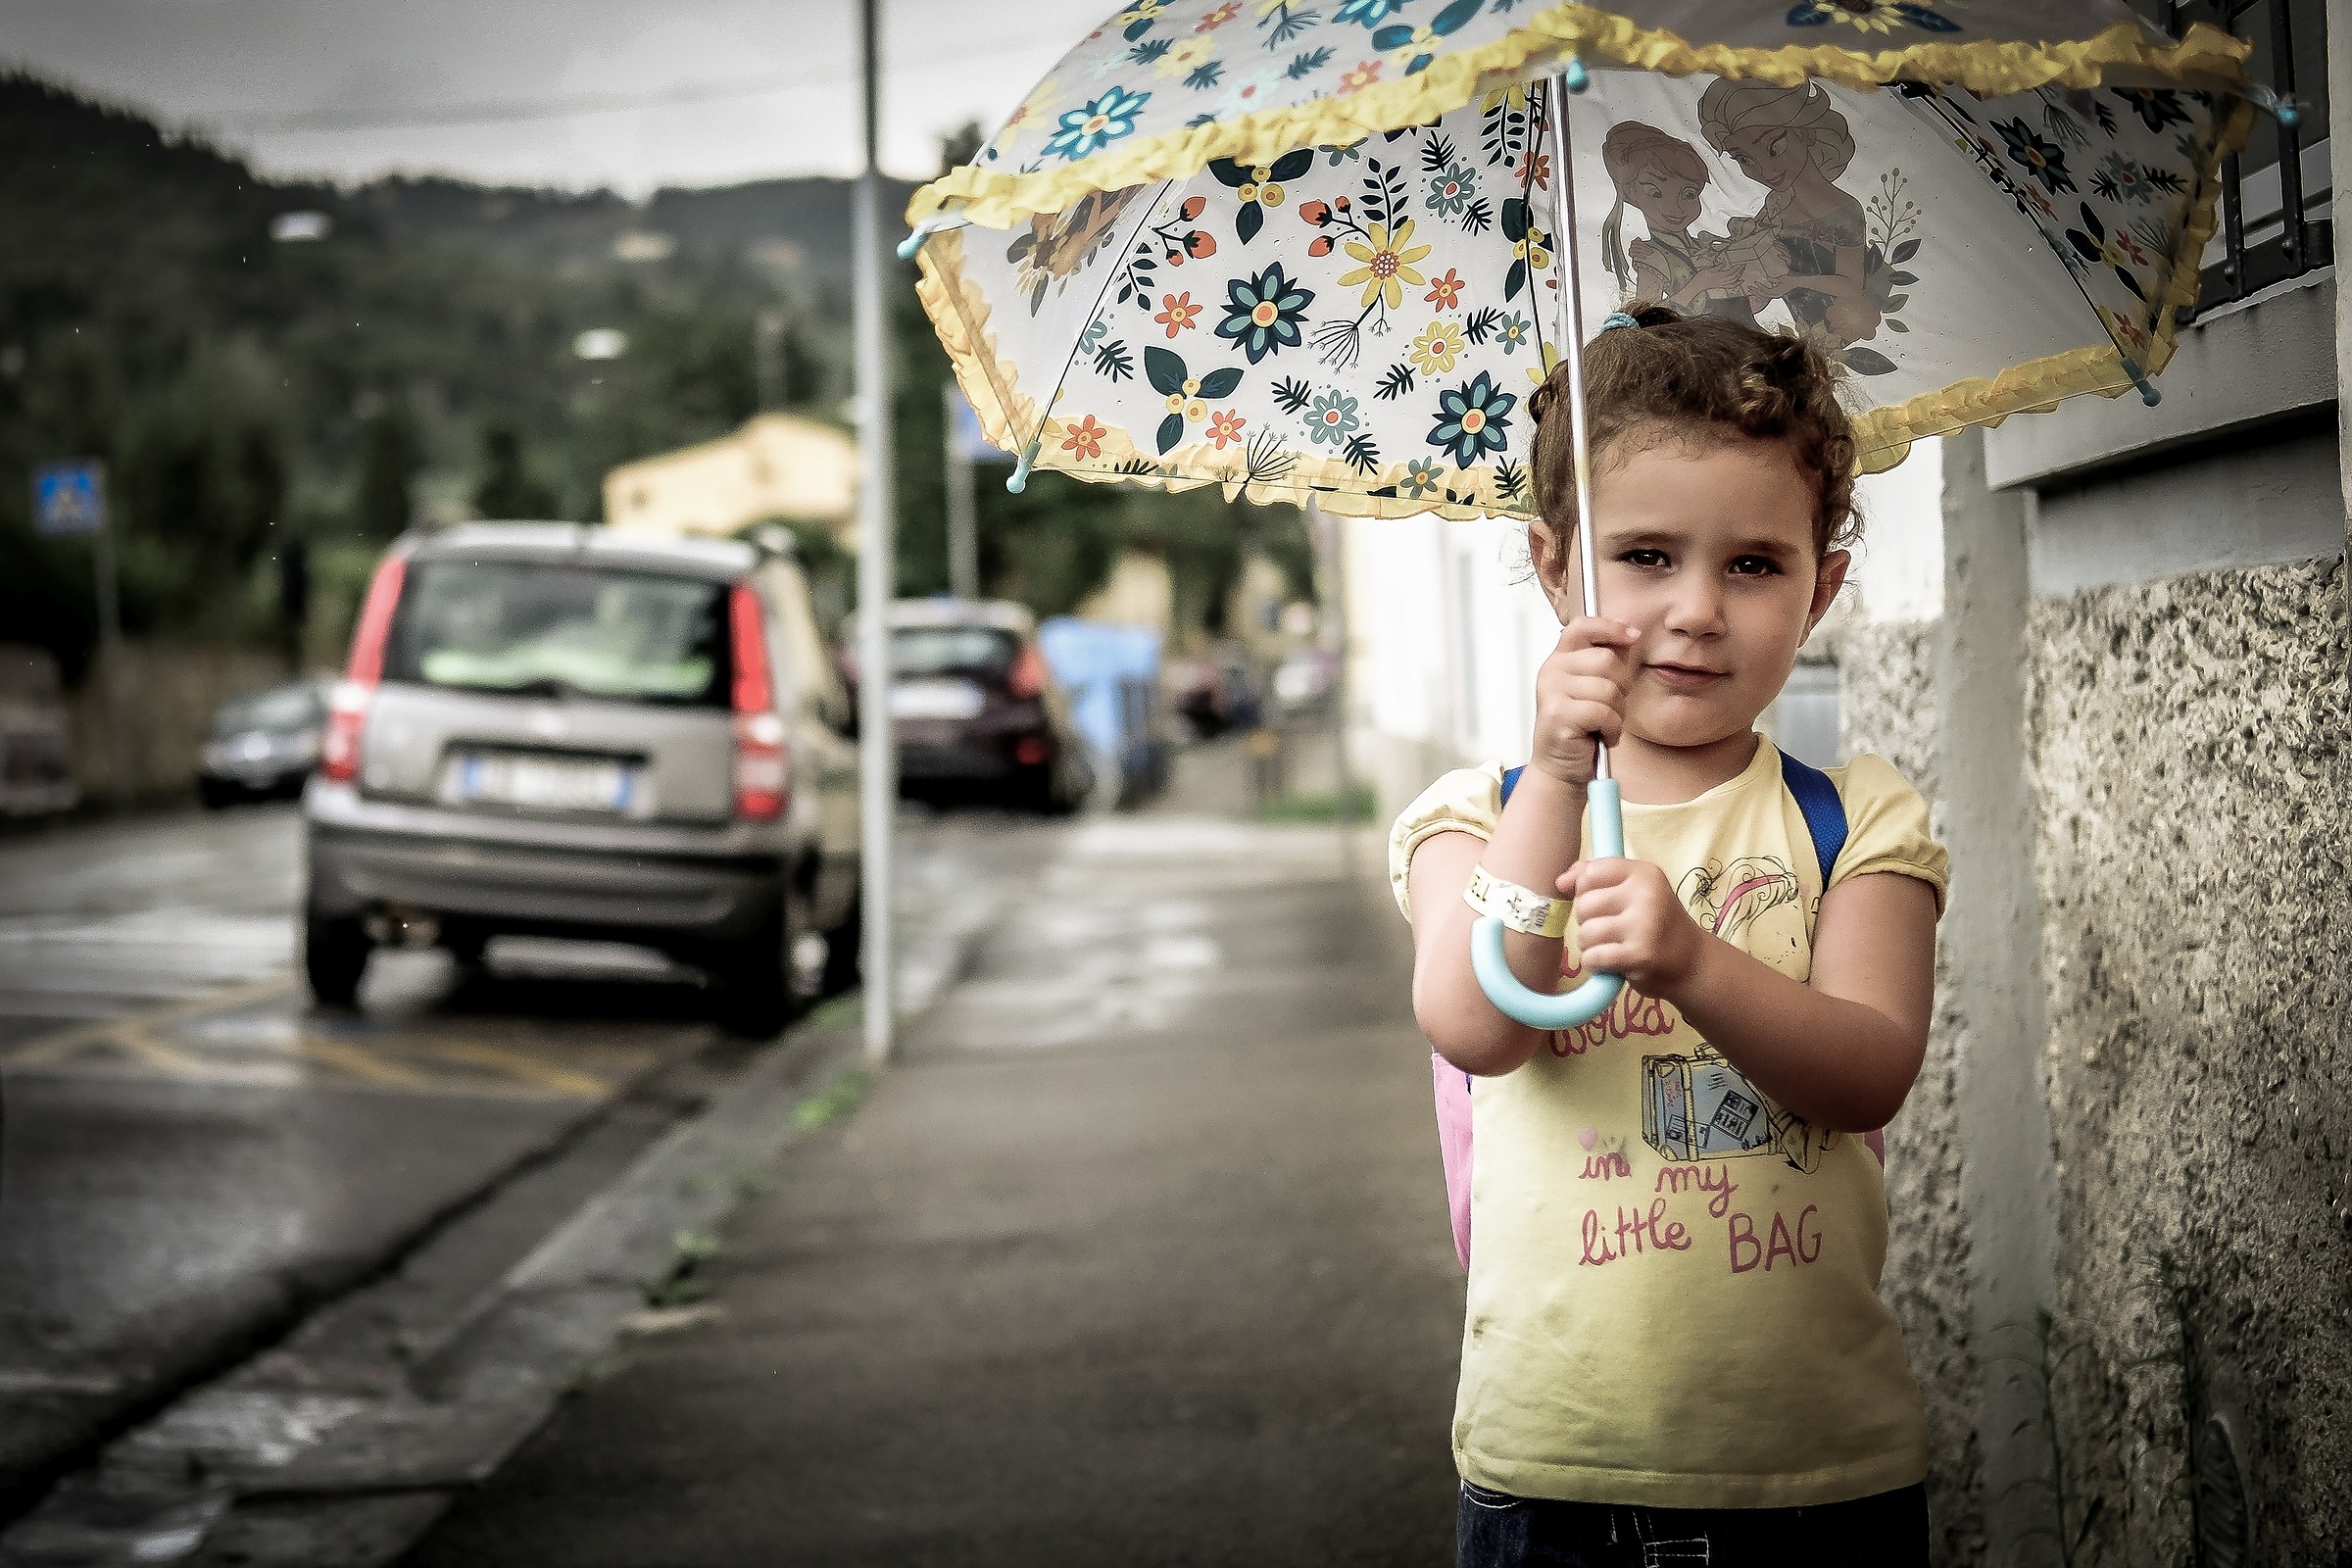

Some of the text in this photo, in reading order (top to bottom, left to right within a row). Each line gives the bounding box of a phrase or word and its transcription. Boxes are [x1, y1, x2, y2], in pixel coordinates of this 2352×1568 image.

[1579, 1152, 1739, 1218] in my
[1578, 1197, 1823, 1273] little BAG
